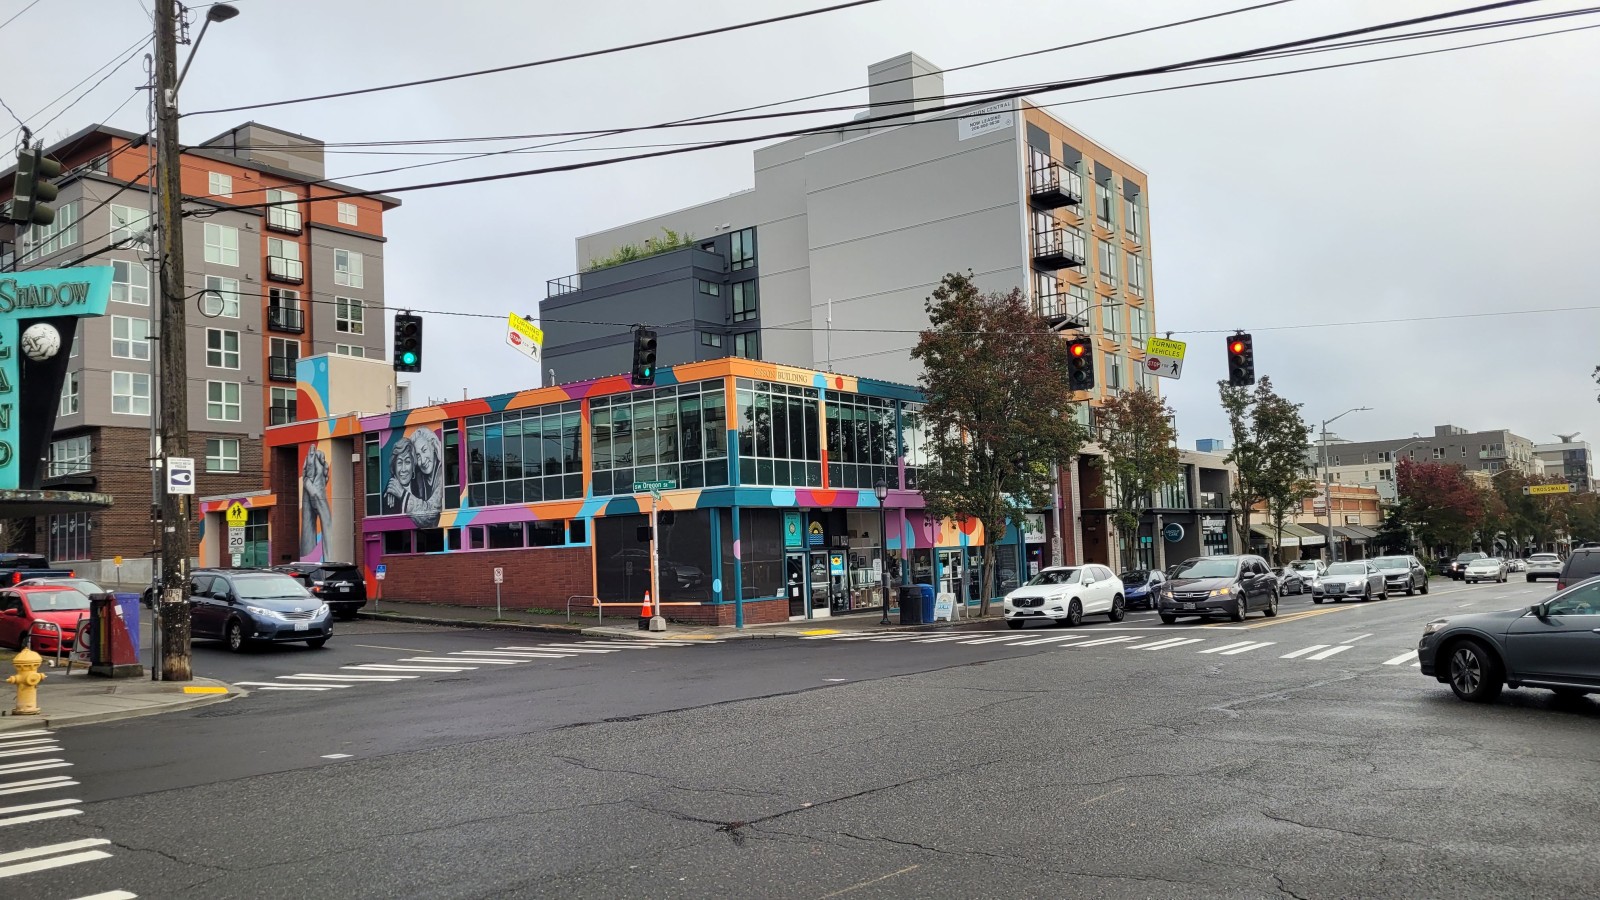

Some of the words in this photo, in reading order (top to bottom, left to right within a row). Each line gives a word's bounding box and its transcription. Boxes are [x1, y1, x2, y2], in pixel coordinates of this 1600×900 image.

[513, 316, 540, 336] TURNING
[1152, 340, 1182, 351] TURNING
[1152, 347, 1180, 358] VEHICLES
[1148, 360, 1160, 368] STOP
[778, 372, 808, 384] BUILDING
[642, 482, 662, 490] Oregon
[230, 537, 243, 546] 20
